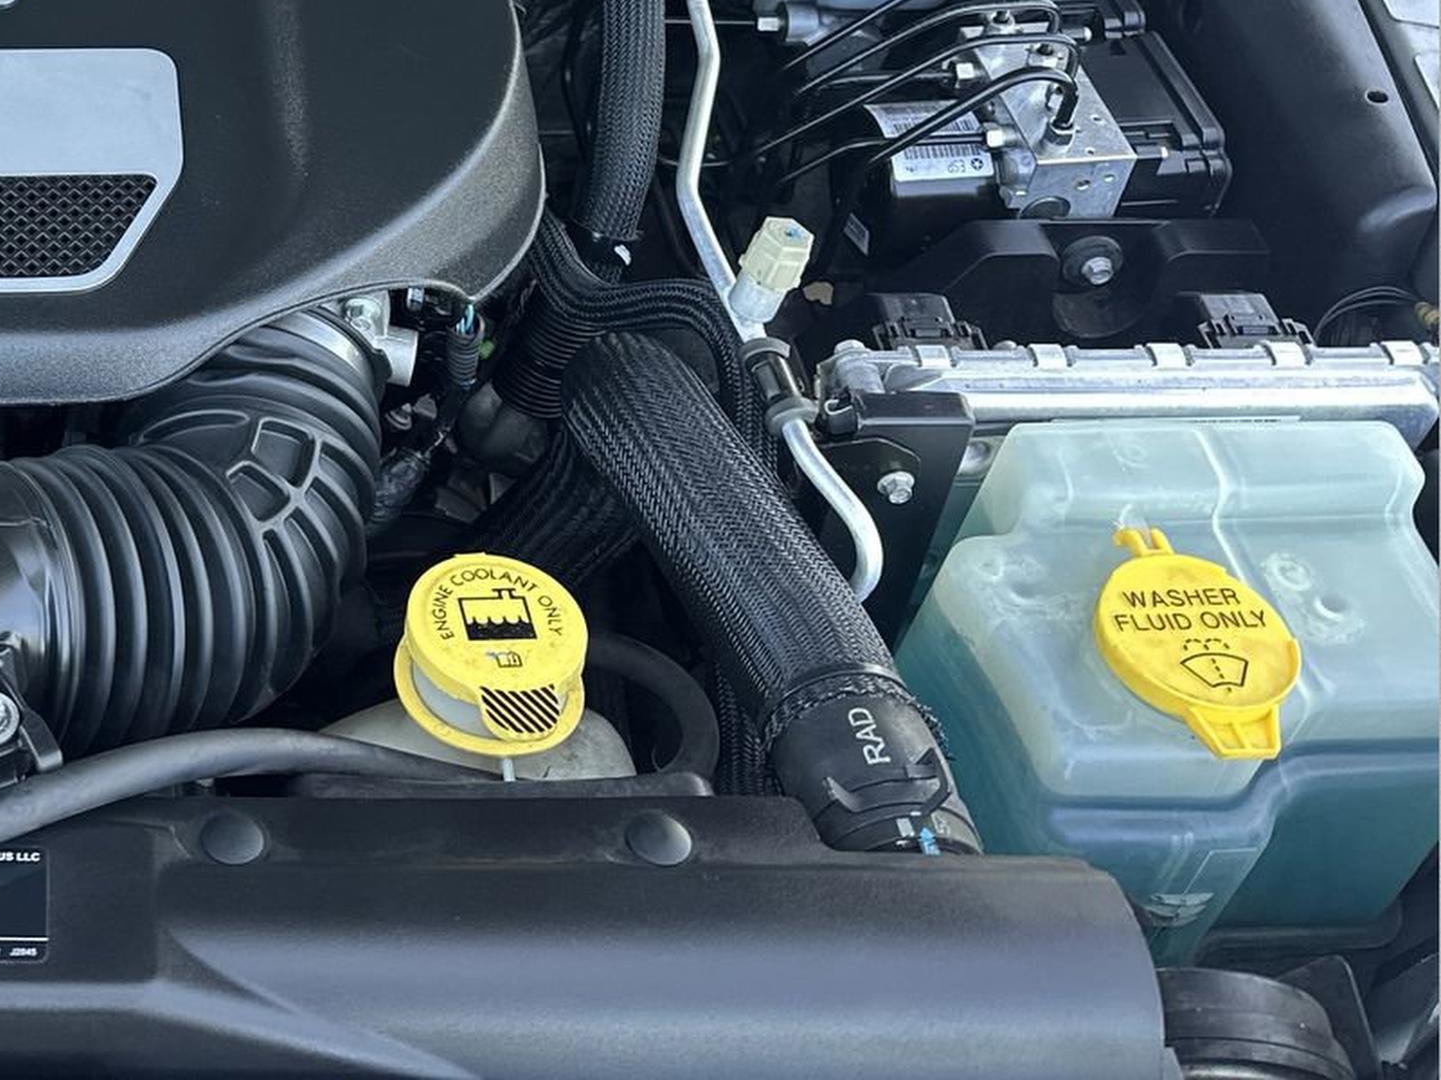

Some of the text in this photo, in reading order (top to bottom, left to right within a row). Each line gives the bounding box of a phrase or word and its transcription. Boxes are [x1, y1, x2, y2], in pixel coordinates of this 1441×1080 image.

[432, 568, 562, 640] ENGINE COOLANT ONLY
[1122, 587, 1241, 609] WASHER
[1114, 610, 1267, 632] FLUID ONLY
[848, 707, 891, 764] RAD
[16, 852, 40, 862] LLC
